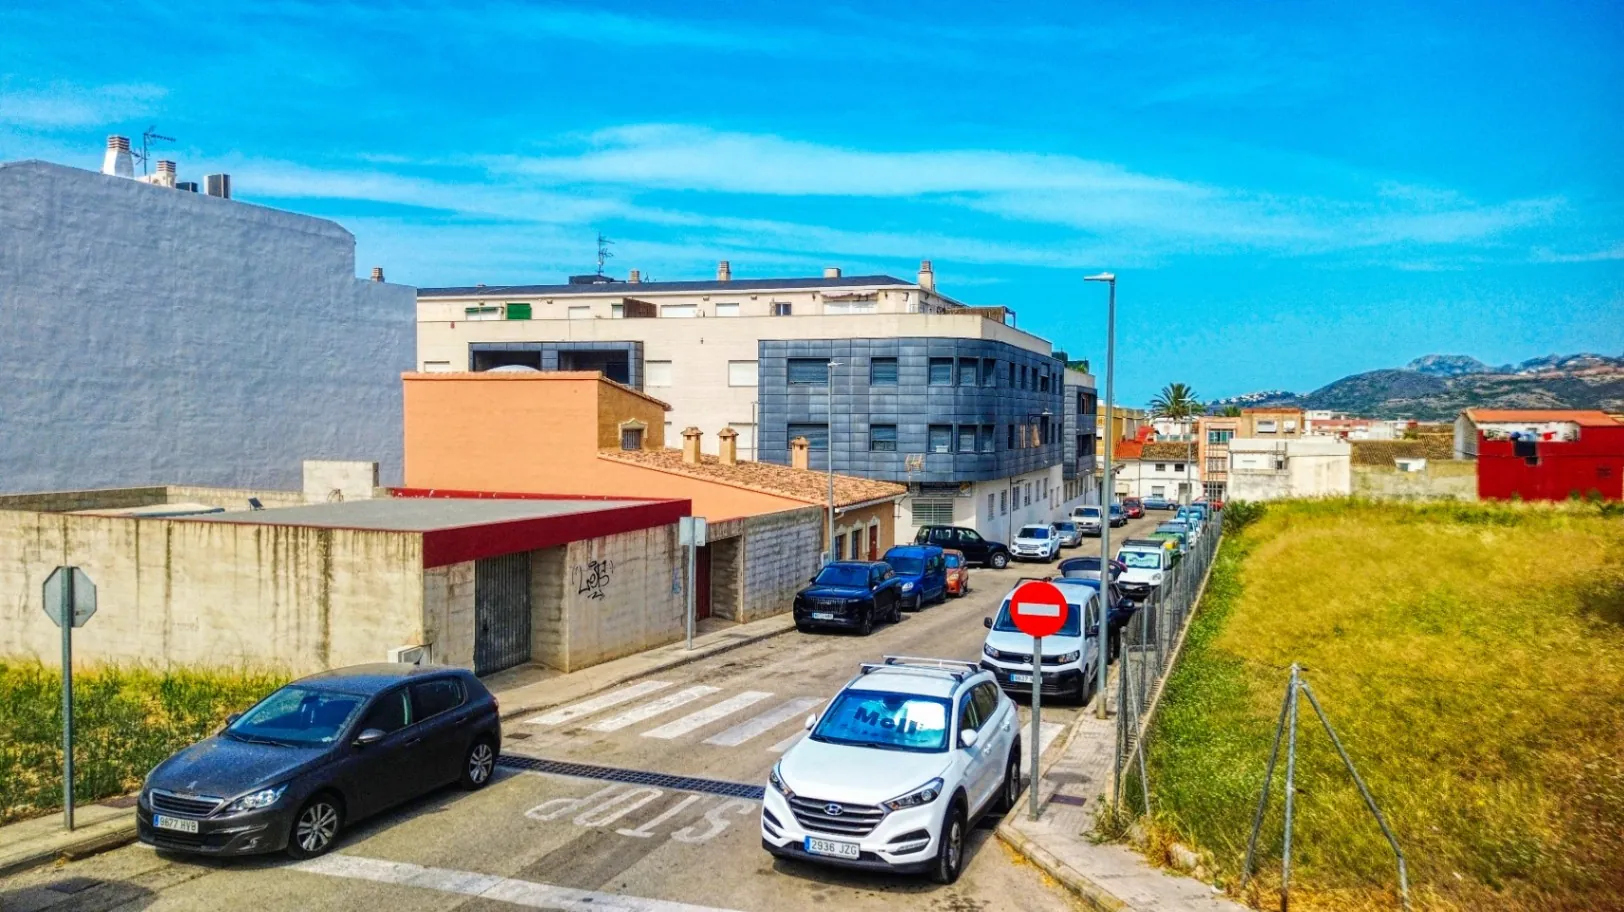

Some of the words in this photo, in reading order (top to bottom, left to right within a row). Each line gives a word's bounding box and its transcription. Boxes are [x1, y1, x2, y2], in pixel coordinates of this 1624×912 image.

[524, 783, 757, 843] STOP
[160, 816, 178, 828] 9677
[811, 840, 835, 852] 2936
[839, 844, 857, 855] JZG
